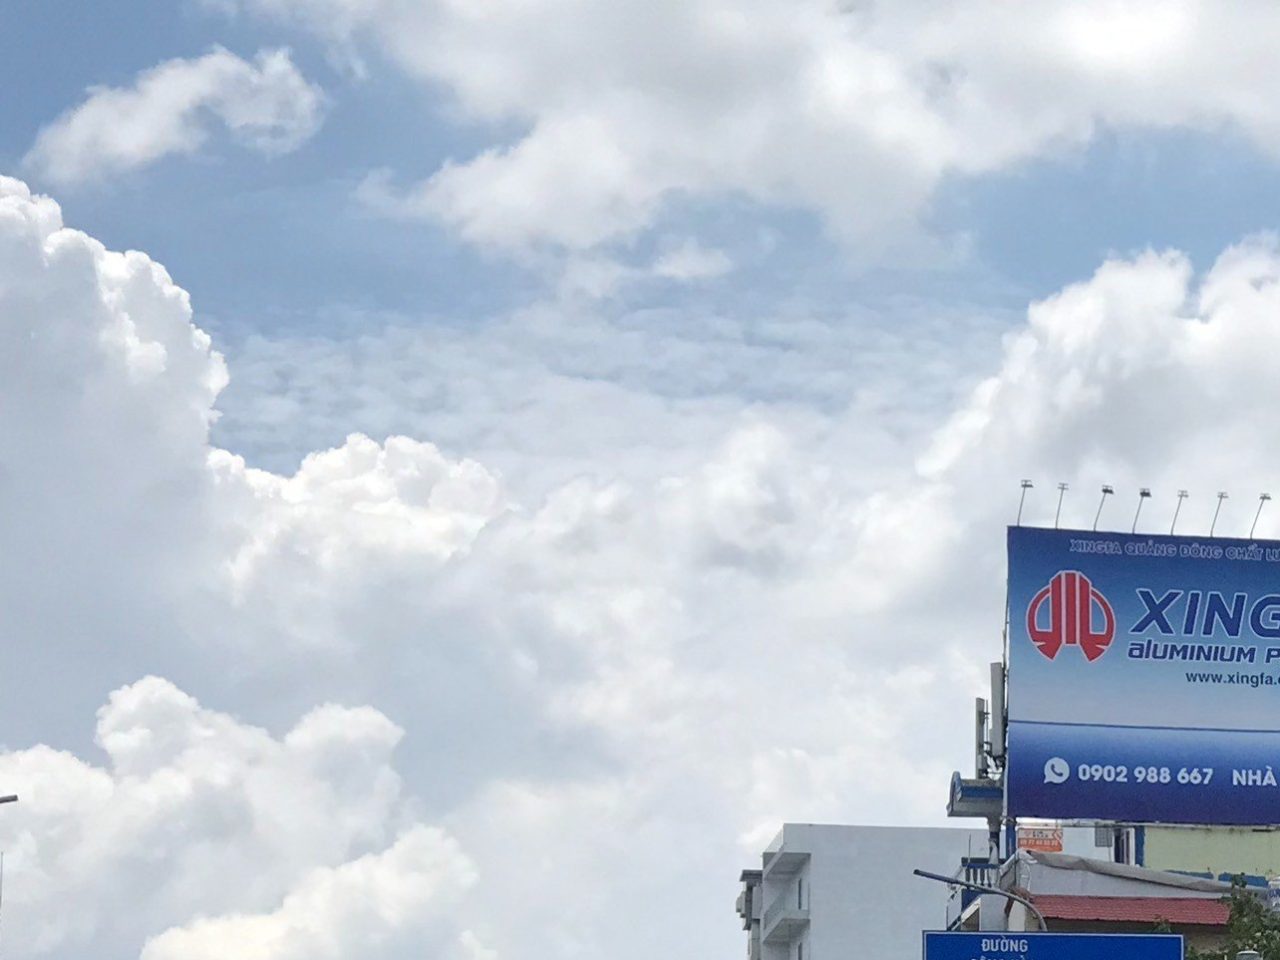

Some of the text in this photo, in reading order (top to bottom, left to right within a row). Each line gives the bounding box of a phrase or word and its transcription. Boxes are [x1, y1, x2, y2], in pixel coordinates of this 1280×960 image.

[1069, 539, 1122, 555] XINGFA
[1125, 539, 1177, 557] QUẢNG
[1225, 543, 1263, 560] CHẤT
[1077, 763, 1214, 786] 0902 988 667
[1232, 765, 1278, 787] NHÀ
[981, 937, 1028, 953] ĐƯỜNG
